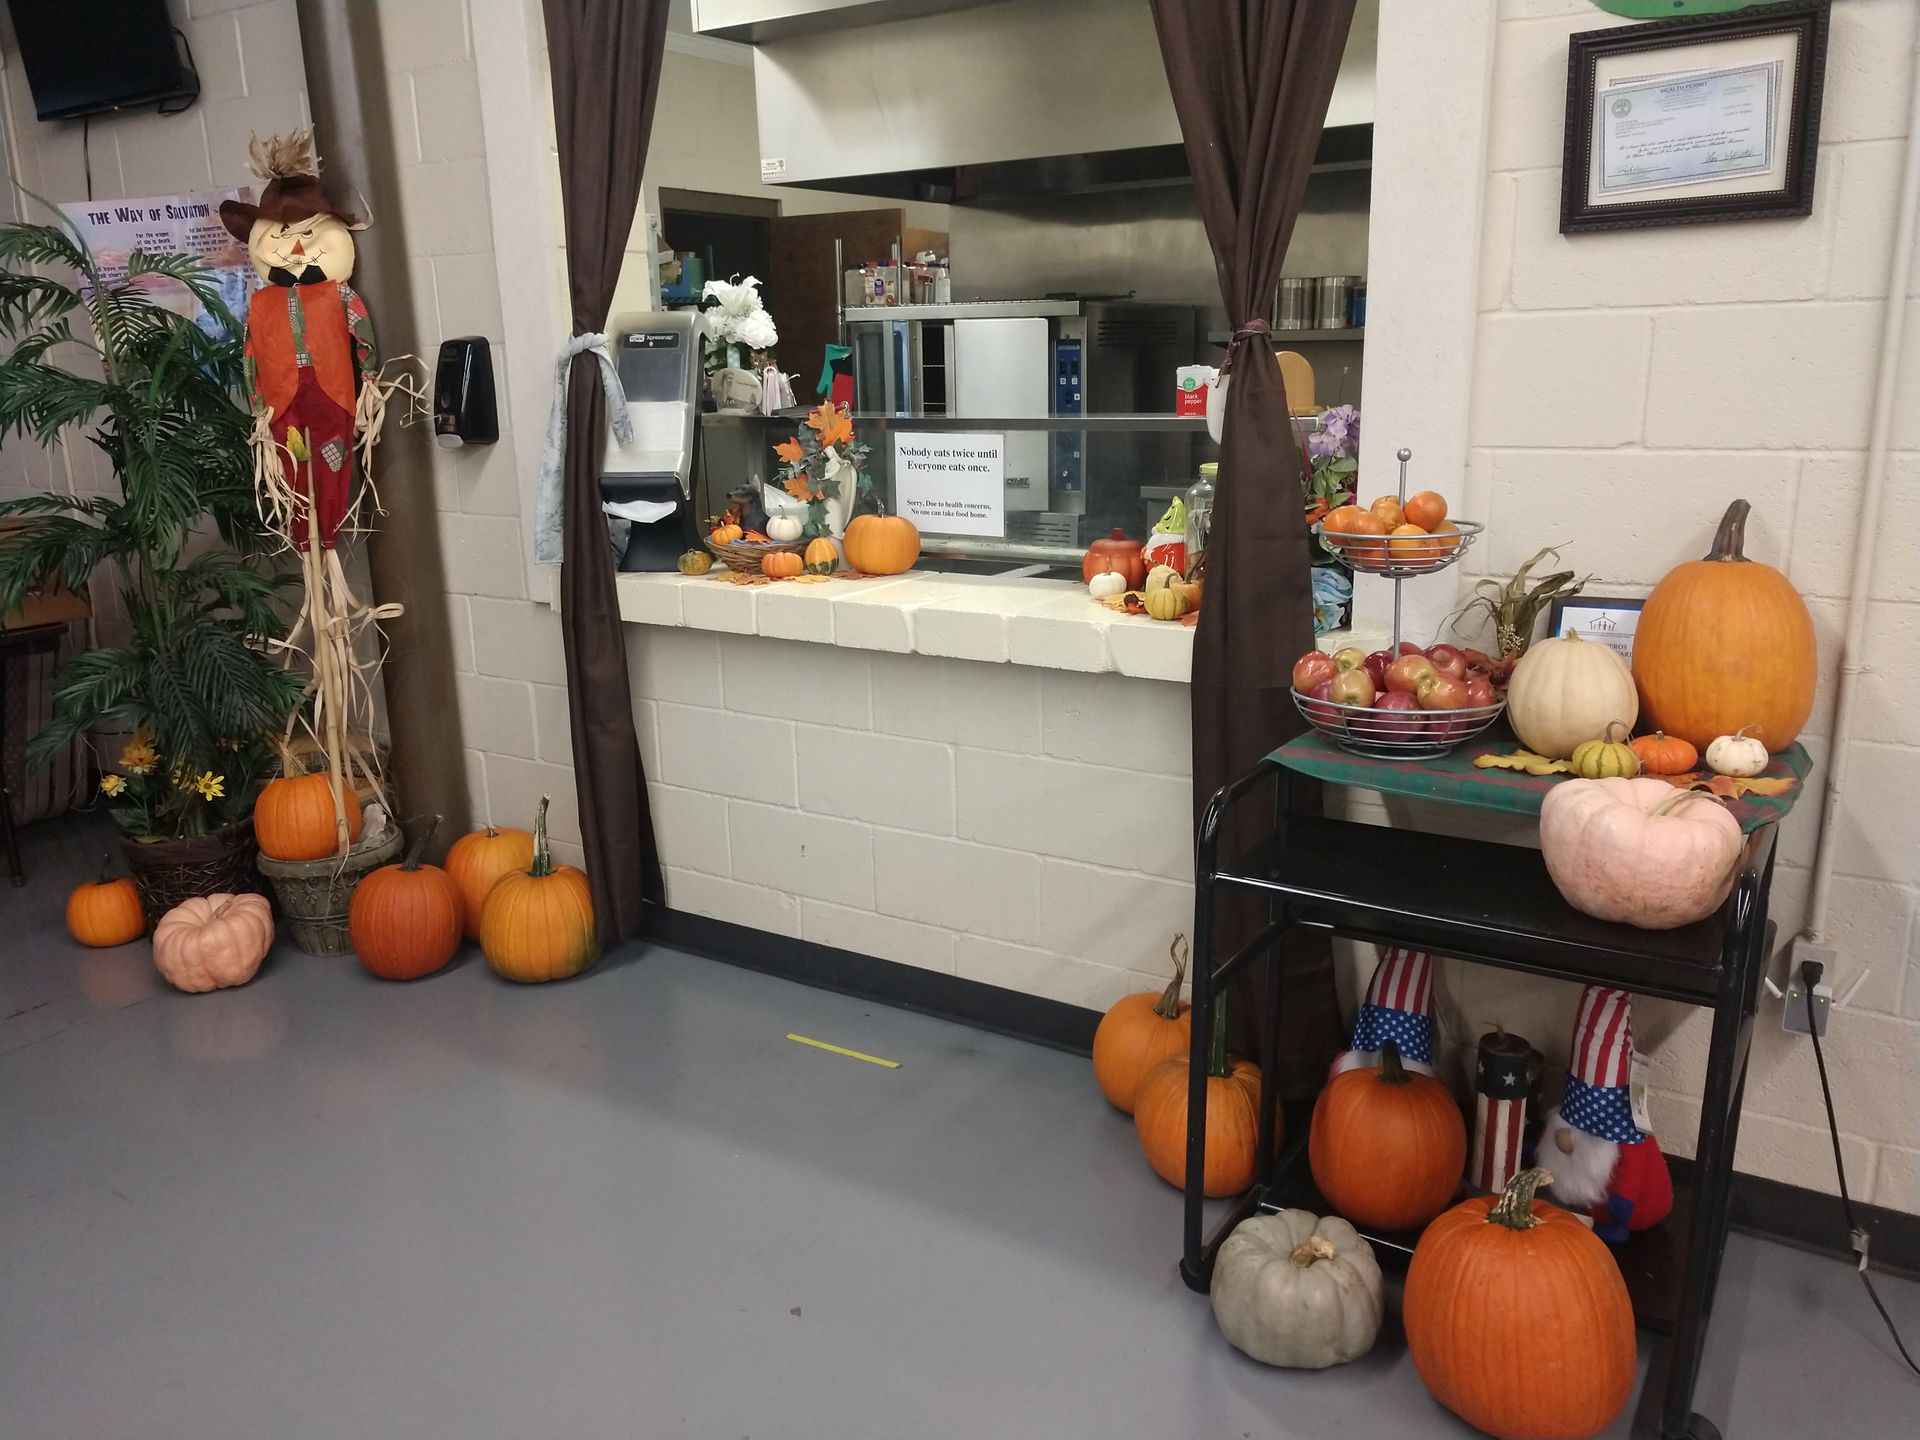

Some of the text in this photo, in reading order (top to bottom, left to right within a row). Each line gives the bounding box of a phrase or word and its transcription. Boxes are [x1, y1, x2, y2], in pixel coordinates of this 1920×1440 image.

[88, 204, 210, 225] THE WAY OF SALVATION
[900, 447, 998, 459] Nobody eats twice until
[907, 460, 990, 472] Everyone eats once.
[945, 501, 963, 509] health
